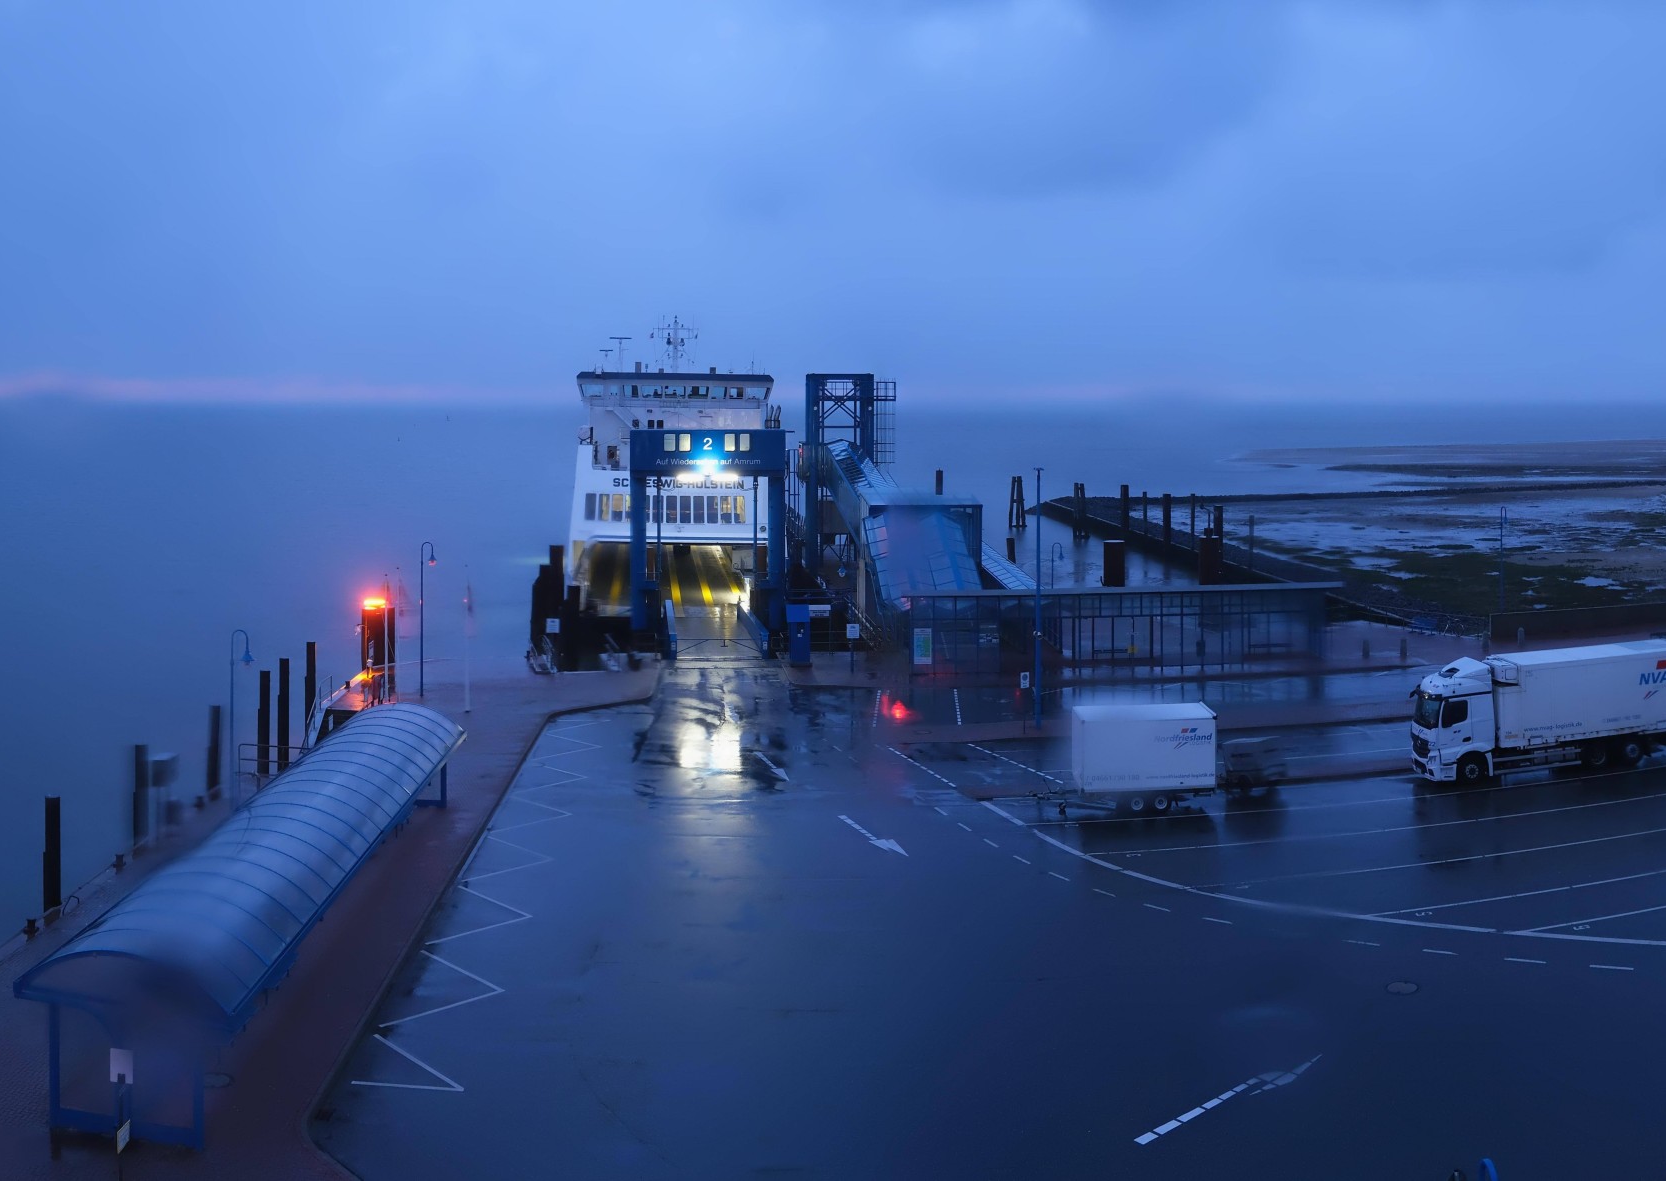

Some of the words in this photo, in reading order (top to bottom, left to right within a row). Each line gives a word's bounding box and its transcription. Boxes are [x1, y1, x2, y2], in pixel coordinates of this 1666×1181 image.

[703, 437, 713, 450] 2
[655, 458, 669, 466] Auf
[720, 458, 732, 466] auf
[734, 458, 761, 466] Amrum
[612, 477, 745, 490] SCESWIG-HOLSTEIN
[1153, 732, 1213, 743] Nordfriesland
